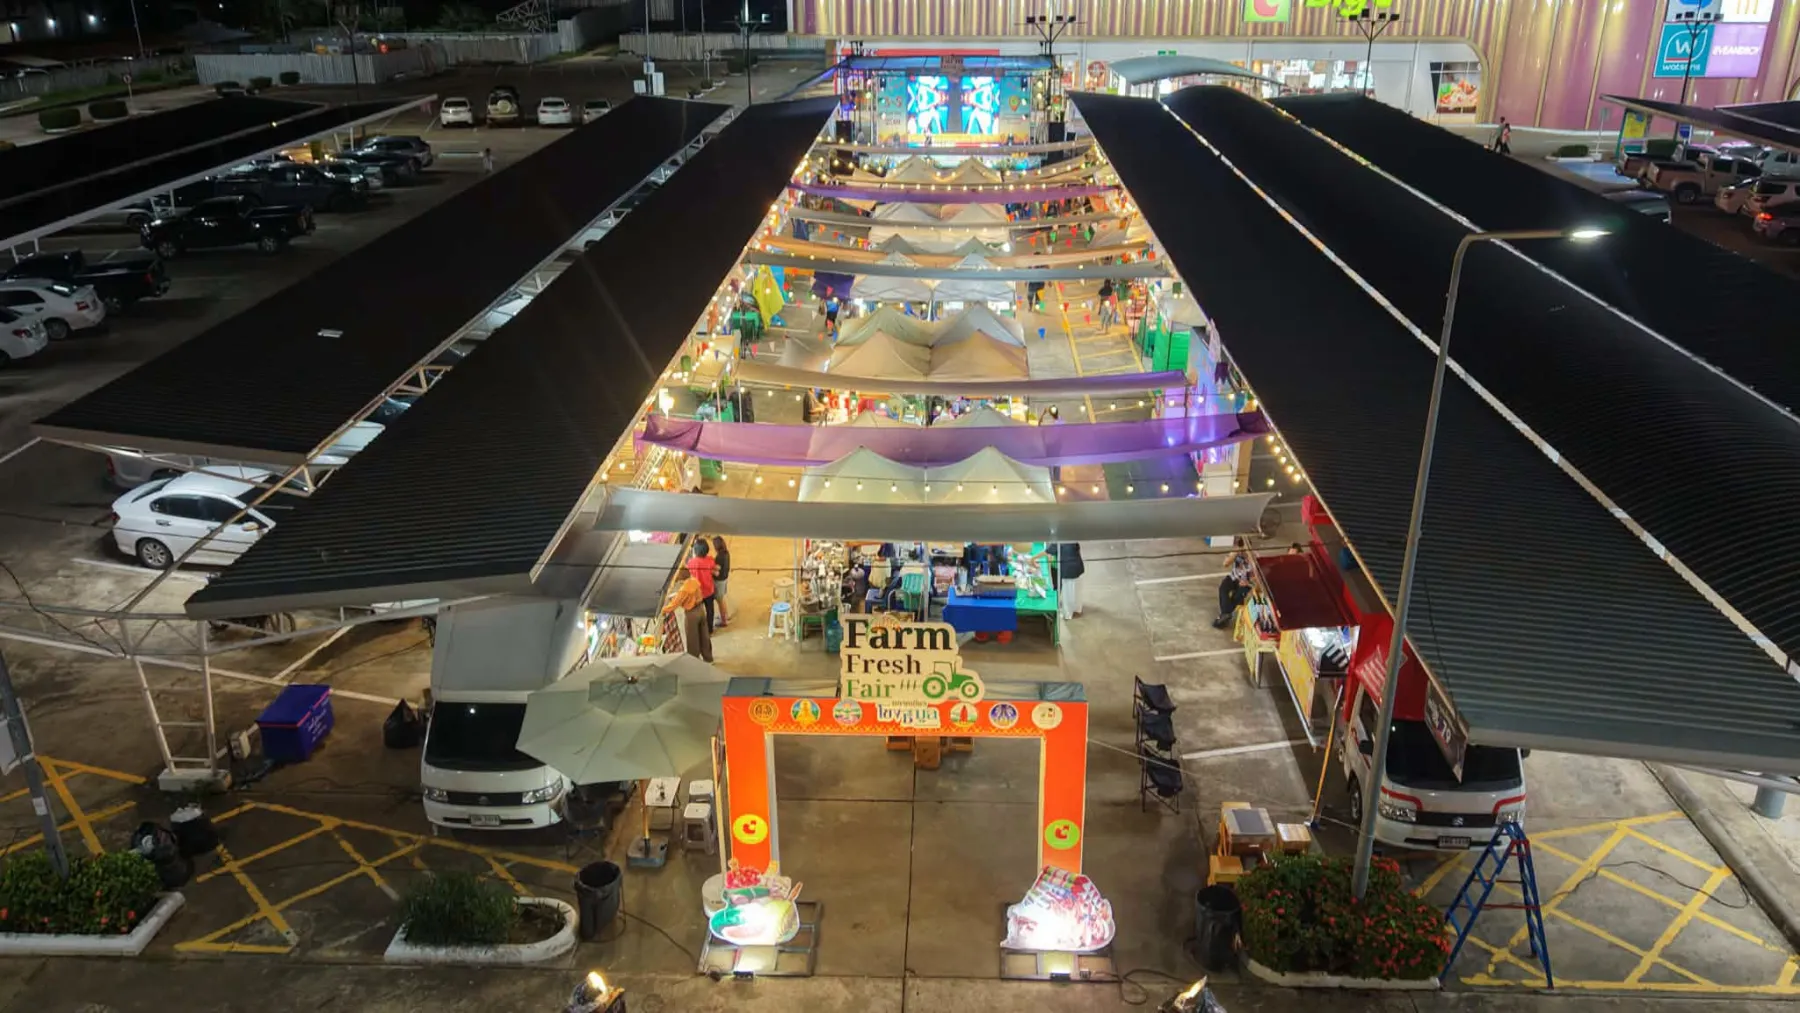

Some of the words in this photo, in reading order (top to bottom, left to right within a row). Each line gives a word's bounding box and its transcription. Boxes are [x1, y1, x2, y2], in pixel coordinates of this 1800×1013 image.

[845, 619, 953, 650] Farm
[846, 654, 921, 675] Fresh
[846, 679, 896, 698] Fair
